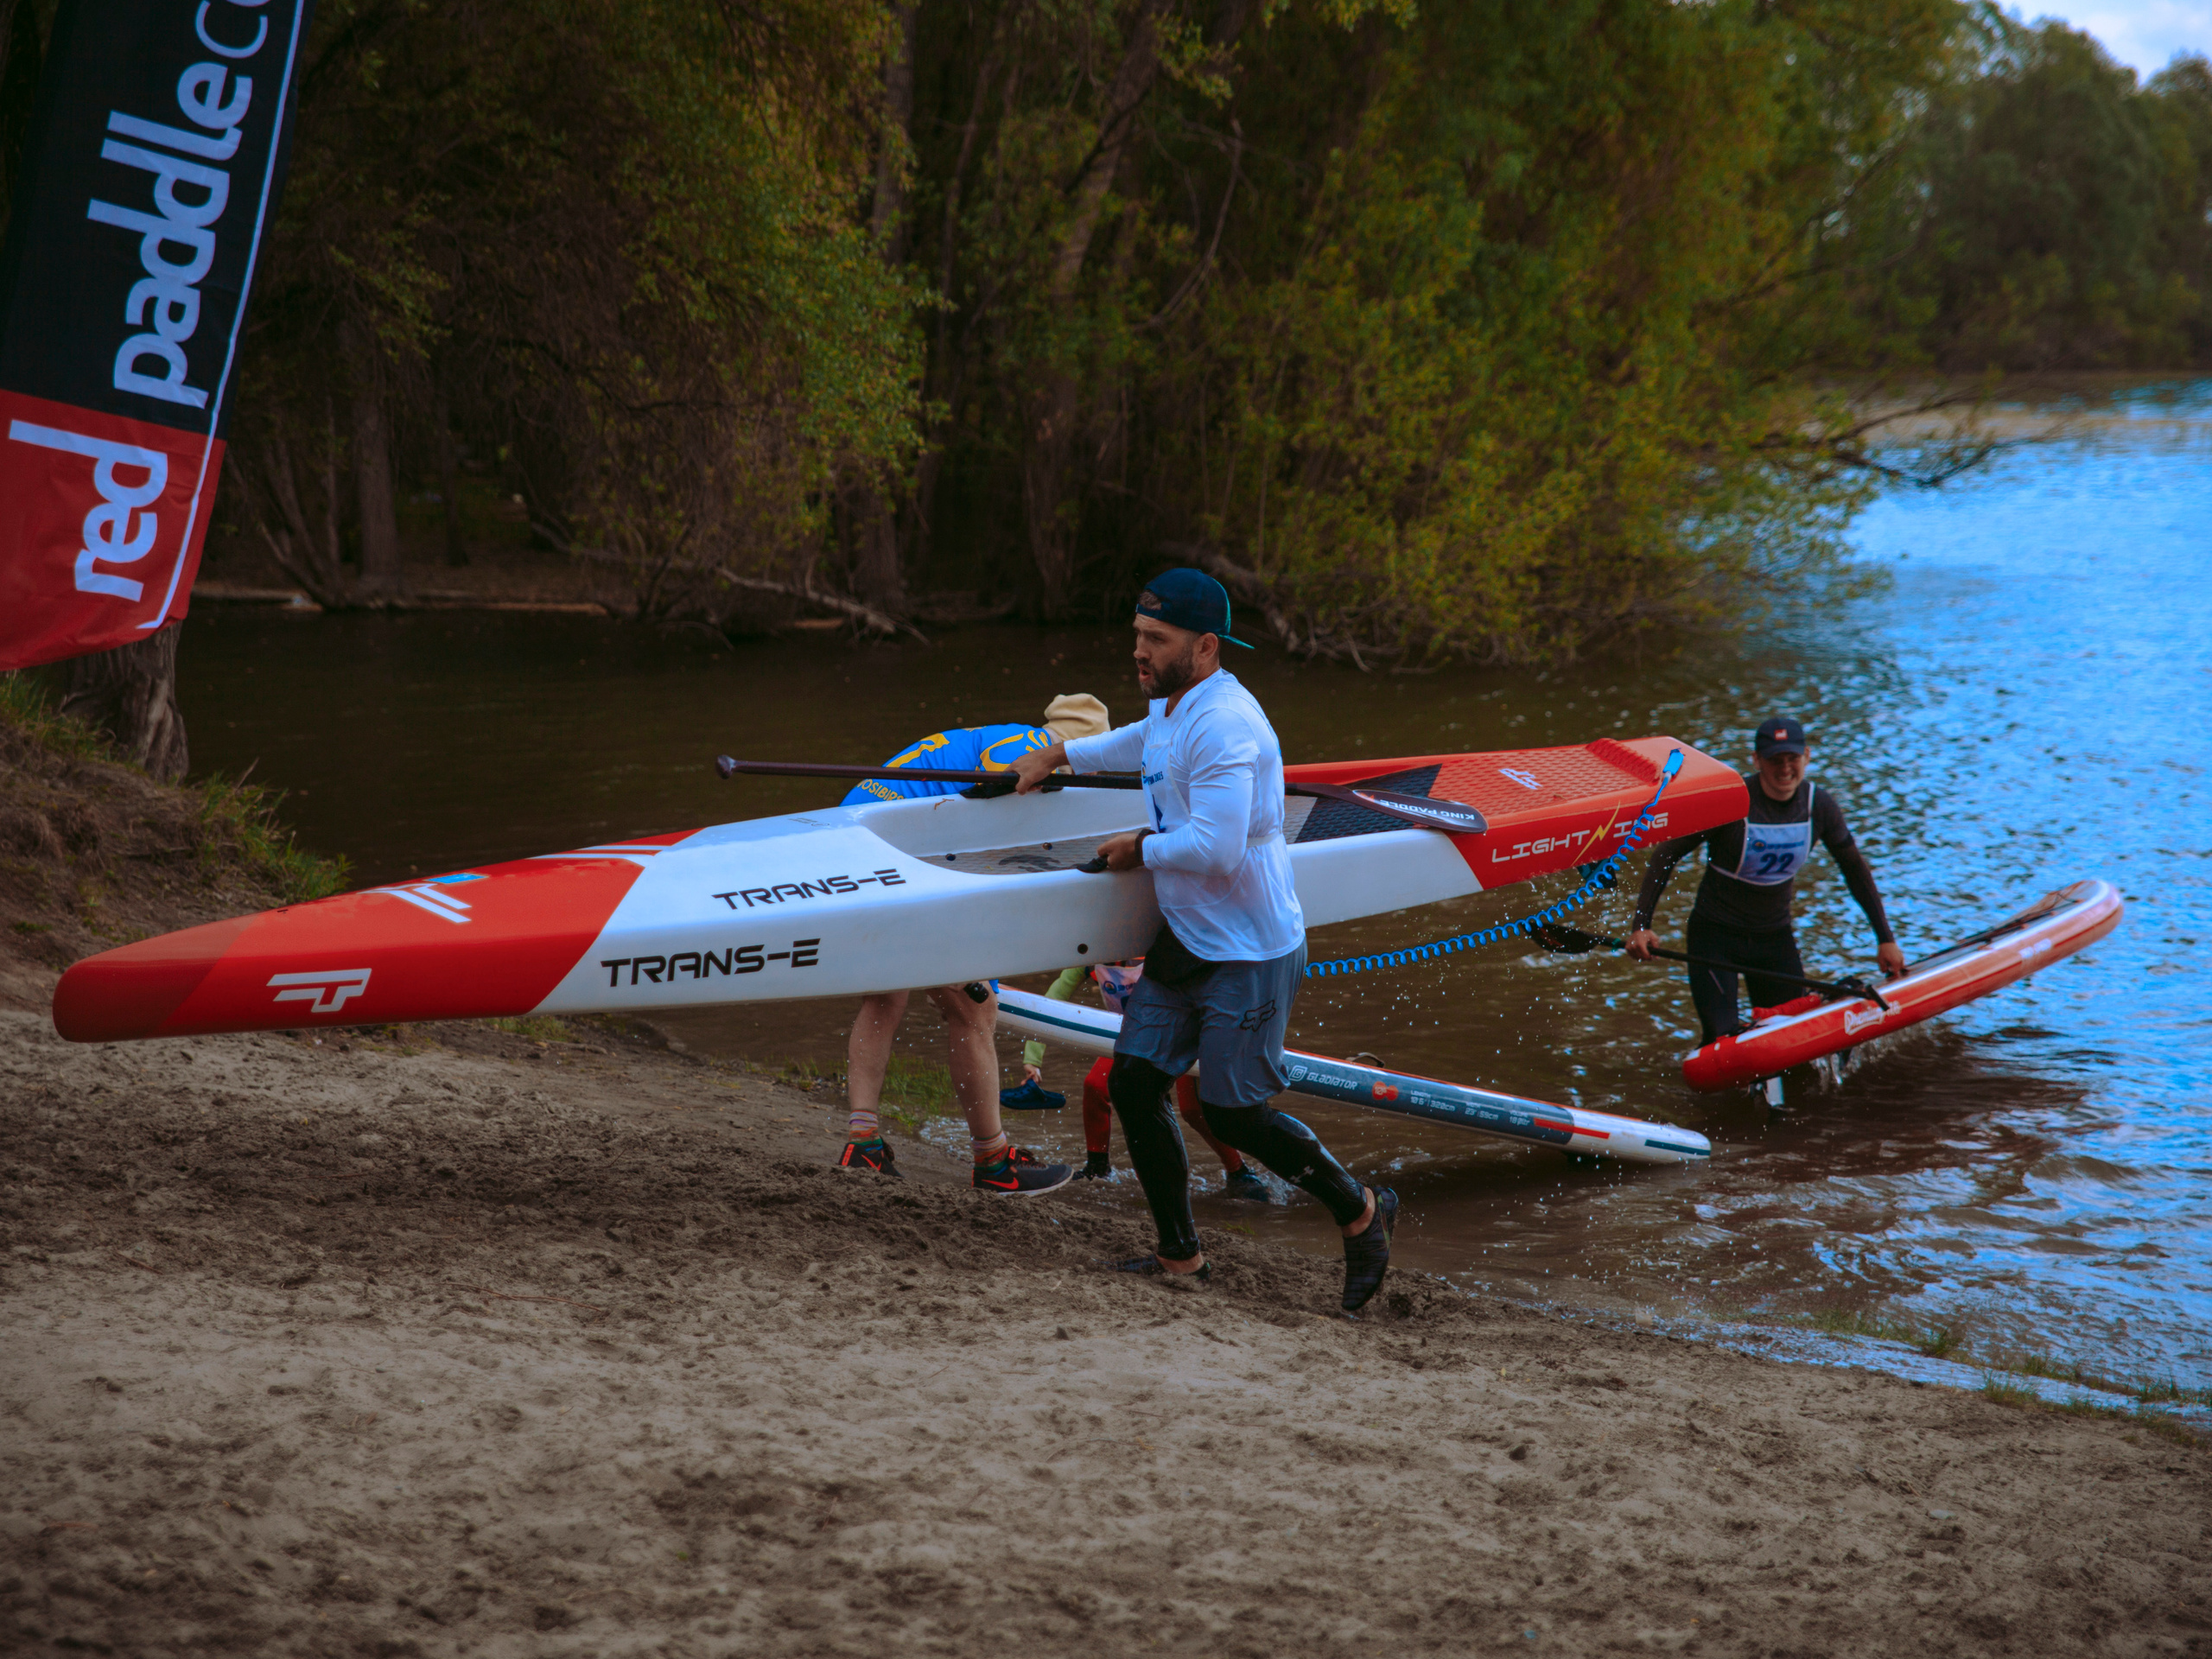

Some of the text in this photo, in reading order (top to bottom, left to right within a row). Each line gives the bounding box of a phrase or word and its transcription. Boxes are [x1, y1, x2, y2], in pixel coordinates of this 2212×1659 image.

[10, 0, 270, 602] red paddlec
[1380, 799, 1475, 821] KING PADDLE
[1757, 852, 1795, 875] 22
[711, 868, 906, 911] TRANS-E
[601, 938, 821, 988] TRANS-E
